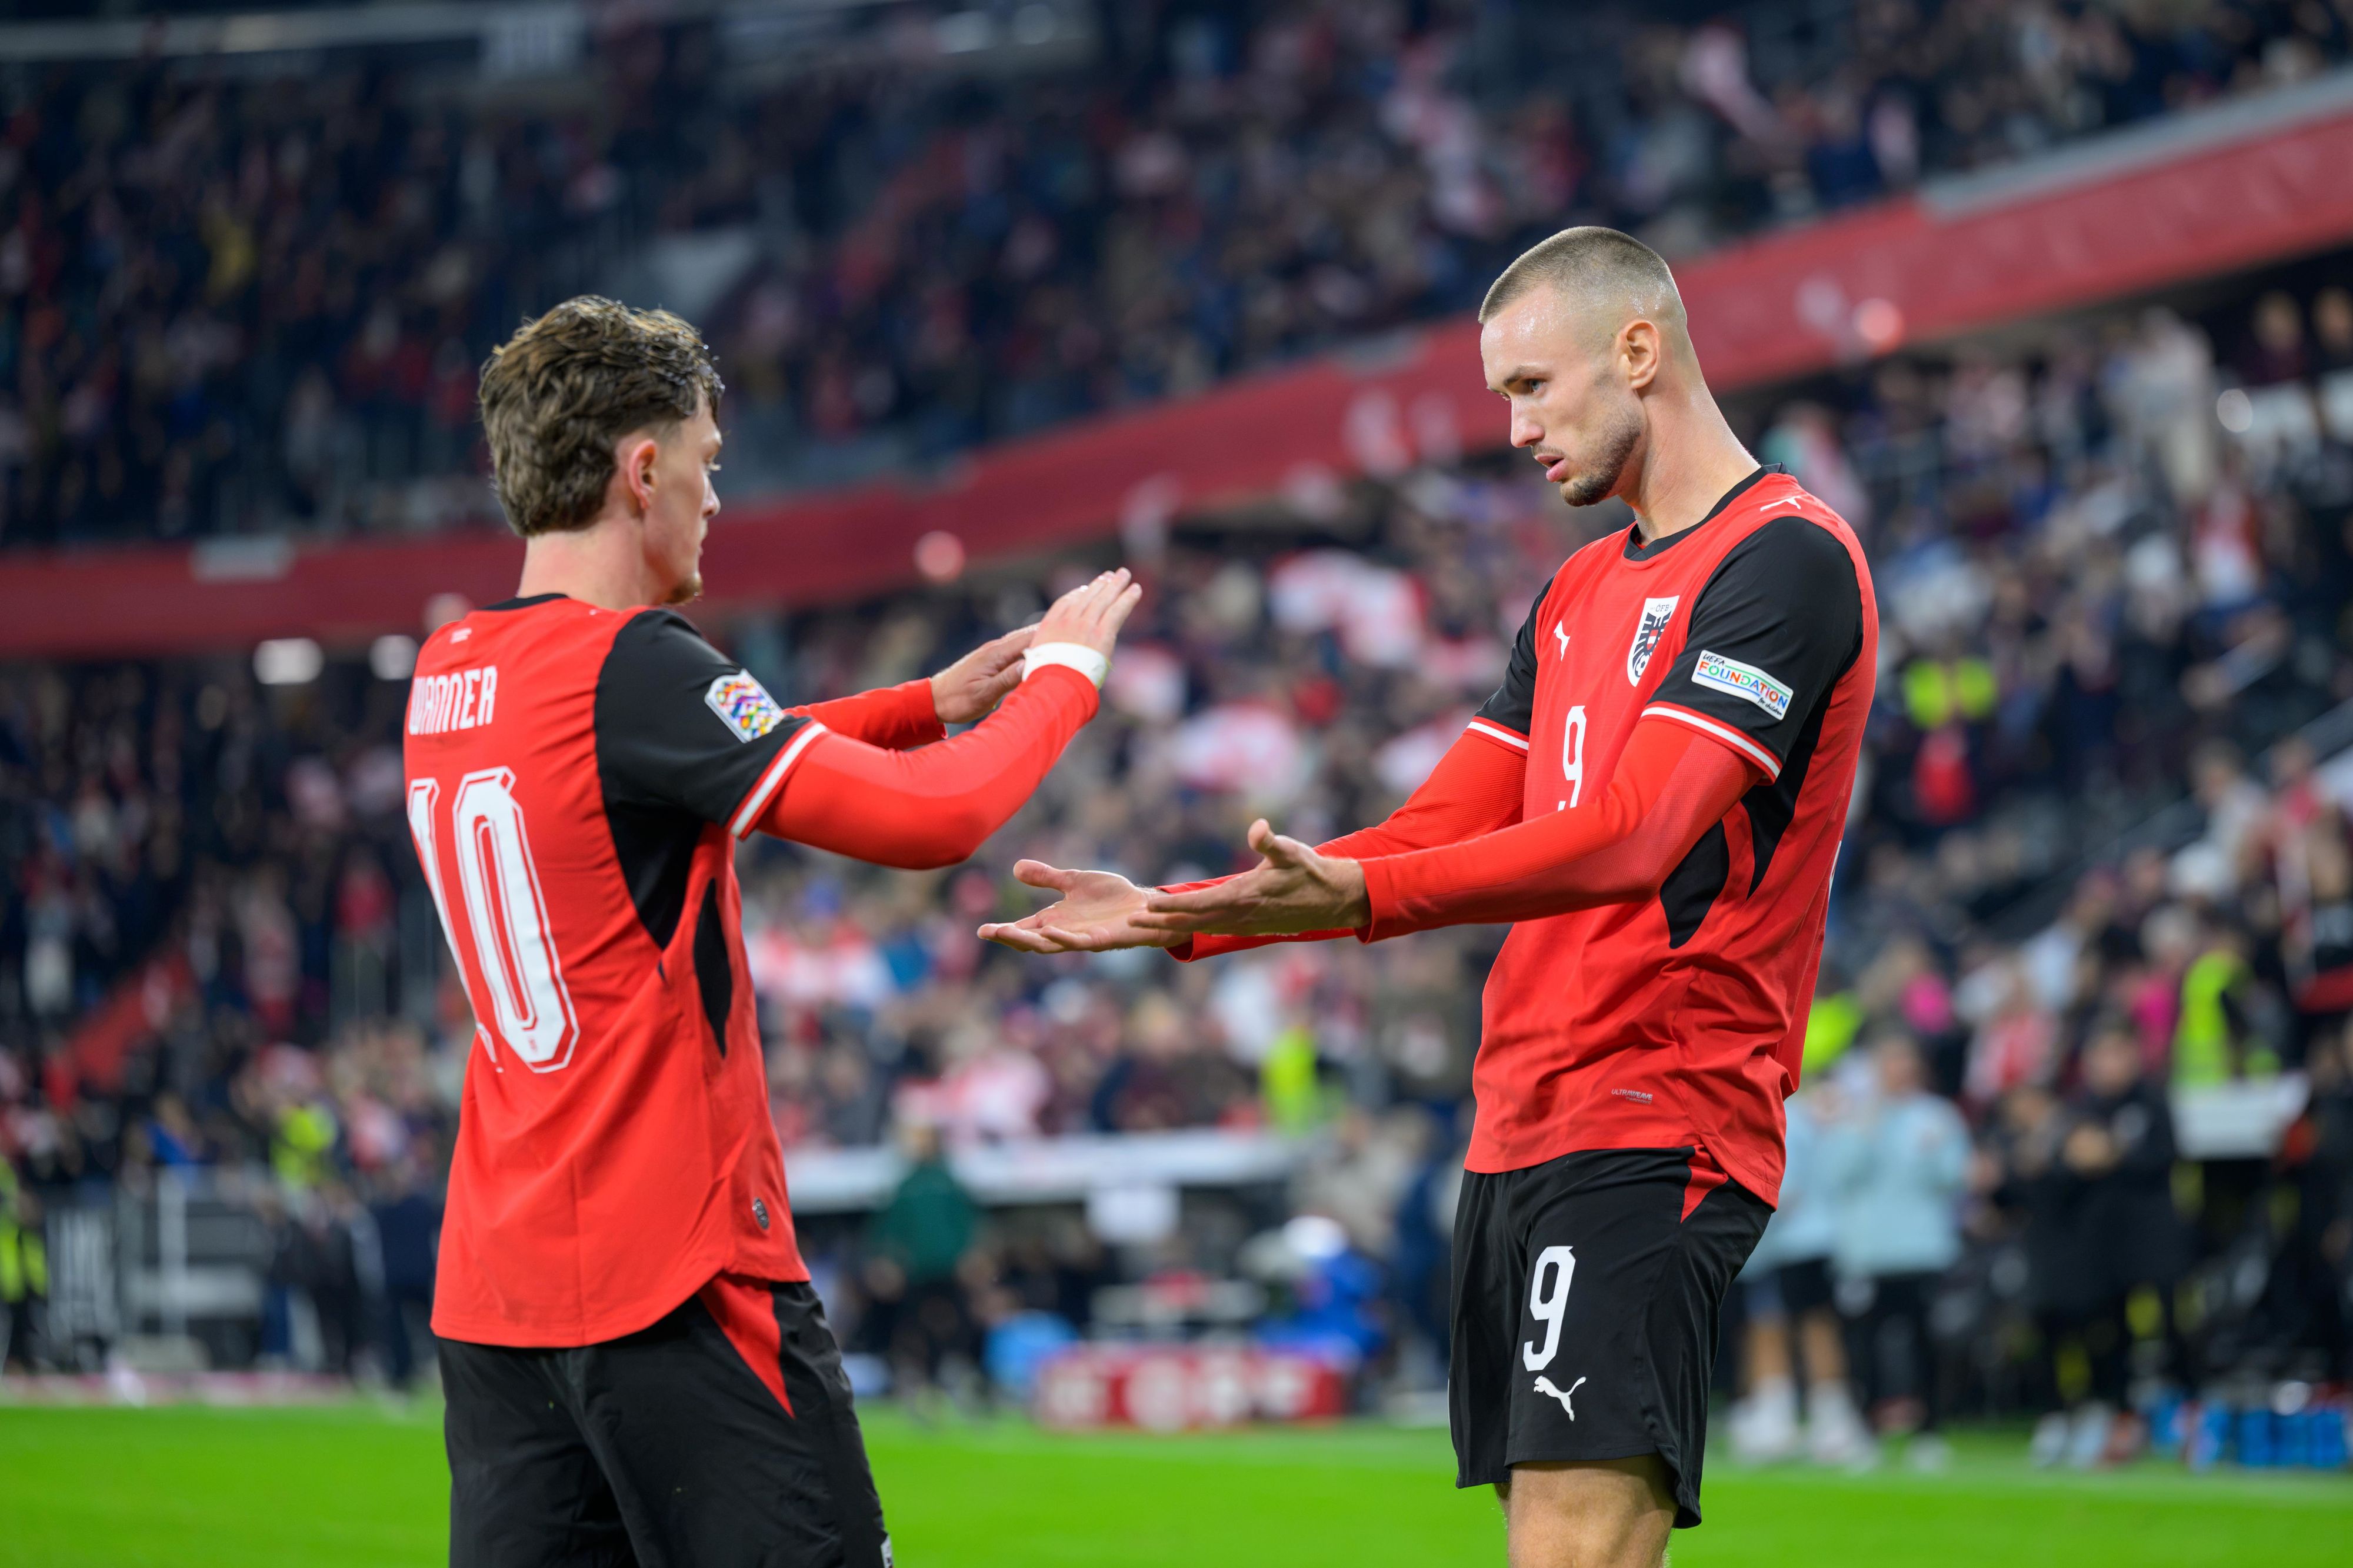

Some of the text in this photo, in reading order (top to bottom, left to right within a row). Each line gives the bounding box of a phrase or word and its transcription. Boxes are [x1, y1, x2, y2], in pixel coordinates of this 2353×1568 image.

[1698, 660, 1788, 709] FOUNDATION
[1702, 653, 1725, 667] UEFA
[408, 665, 498, 735] WANNER
[1765, 702, 1782, 716] children
[1558, 705, 1587, 812] 9
[407, 766, 580, 1073] 10
[1611, 1089, 1653, 1101] ULTRAWEAVE
[1522, 1246, 1577, 1372] 9
